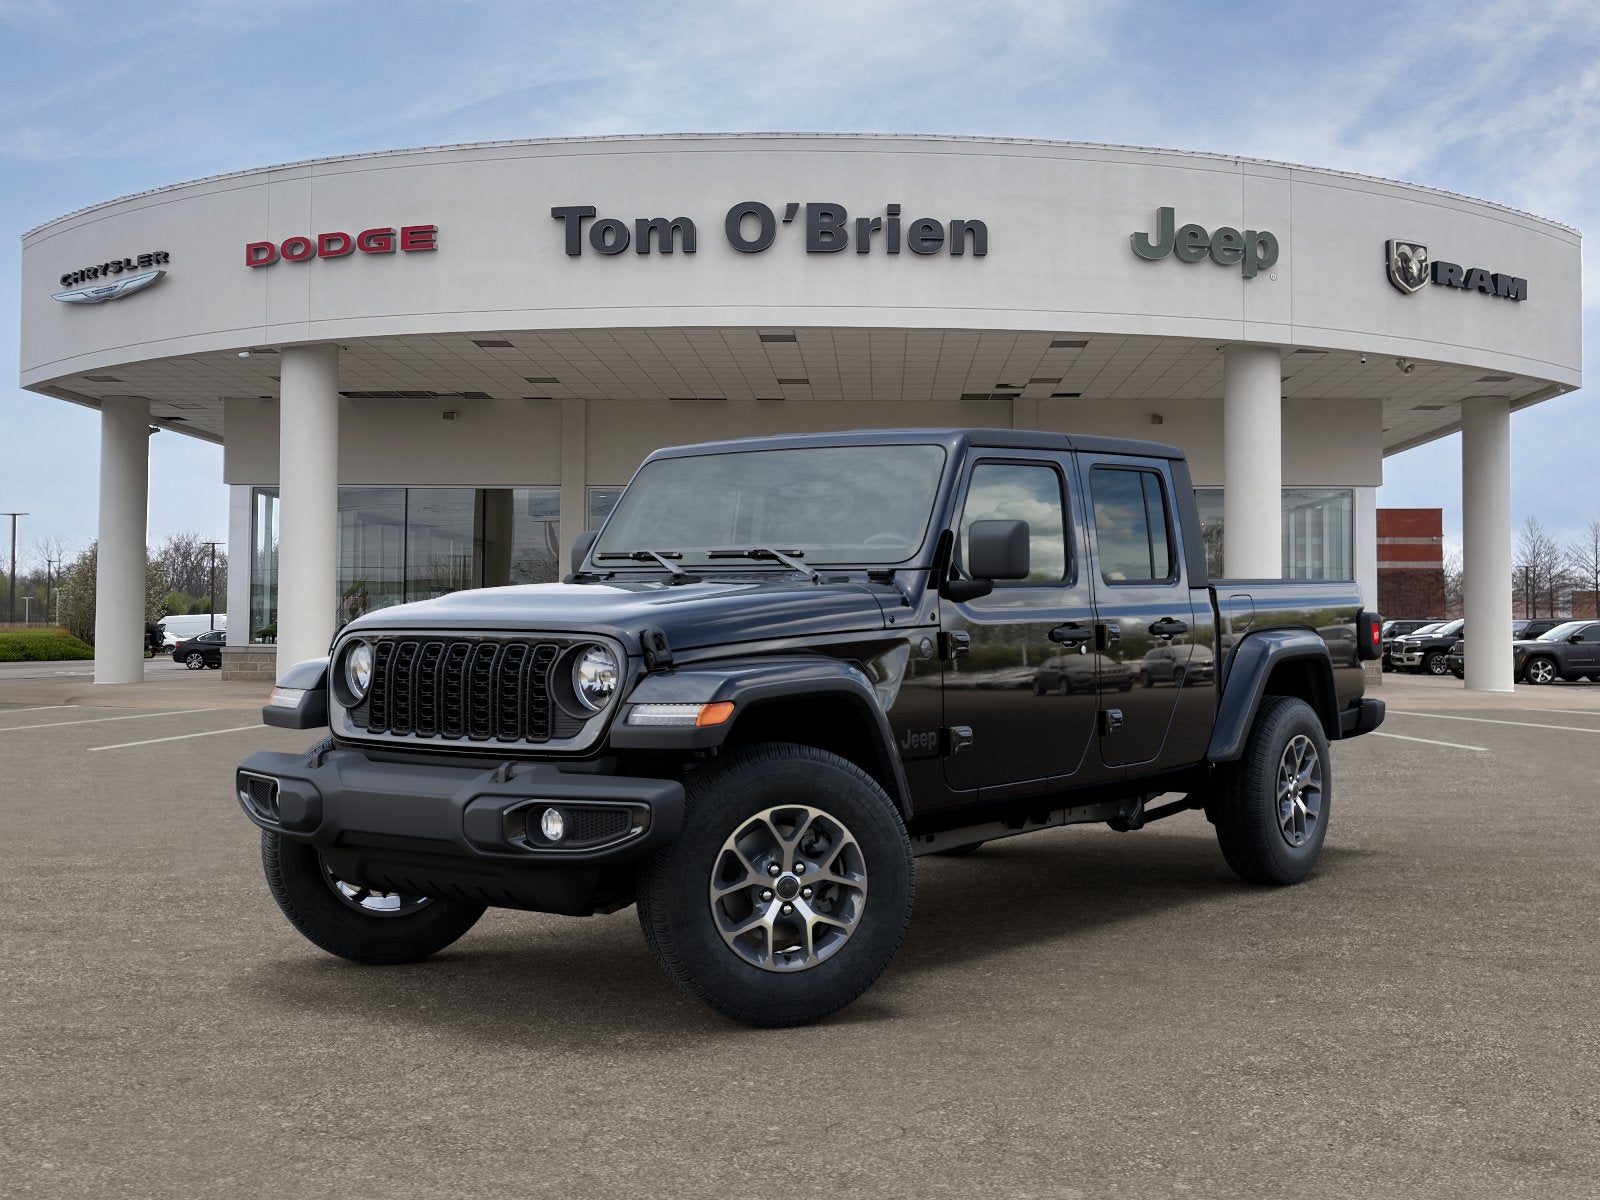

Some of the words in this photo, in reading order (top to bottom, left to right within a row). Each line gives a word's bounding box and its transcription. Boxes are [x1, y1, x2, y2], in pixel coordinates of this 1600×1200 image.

[245, 224, 438, 268] DODGE
[550, 205, 697, 256] Tom
[724, 201, 988, 256] O'Brien
[1130, 206, 1279, 278] Jeep
[60, 251, 170, 286] CHRYSLER
[1430, 260, 1528, 302] RAM
[901, 729, 937, 750] Jeep
